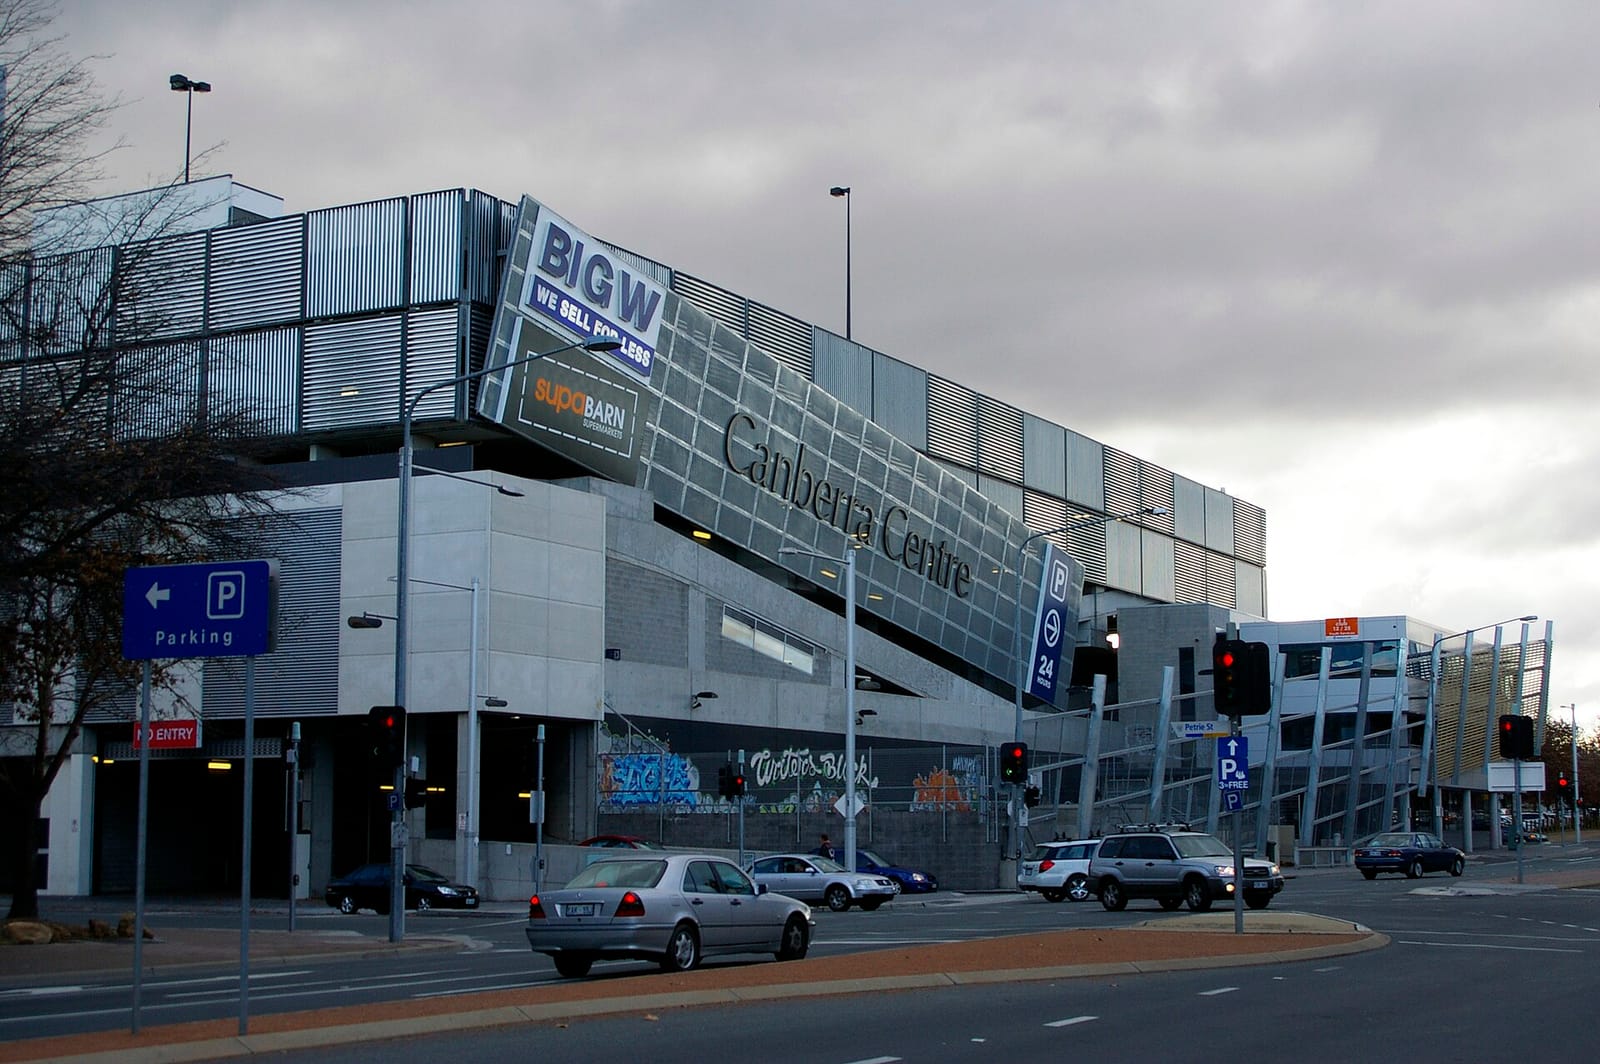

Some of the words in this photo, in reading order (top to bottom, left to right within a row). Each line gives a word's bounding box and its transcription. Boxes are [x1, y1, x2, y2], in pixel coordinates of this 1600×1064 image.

[536, 283, 558, 311] WE
[560, 299, 591, 332] SELL
[620, 336, 651, 367] LESS
[582, 418, 623, 440] SUPERMARKETS
[725, 412, 876, 545] Canberra
[883, 505, 973, 598] Centre
[1054, 567, 1065, 593] P
[217, 581, 236, 610] P
[156, 629, 233, 646] Parking
[1038, 654, 1054, 679] 24
[156, 728, 193, 741] ENTRY
[1184, 723, 1206, 731] Petrie
[1206, 723, 1214, 731] St
[1221, 759, 1237, 780] P
[1228, 780, 1249, 789] FREE
[390, 795, 398, 808] P
[1226, 794, 1238, 809] P
